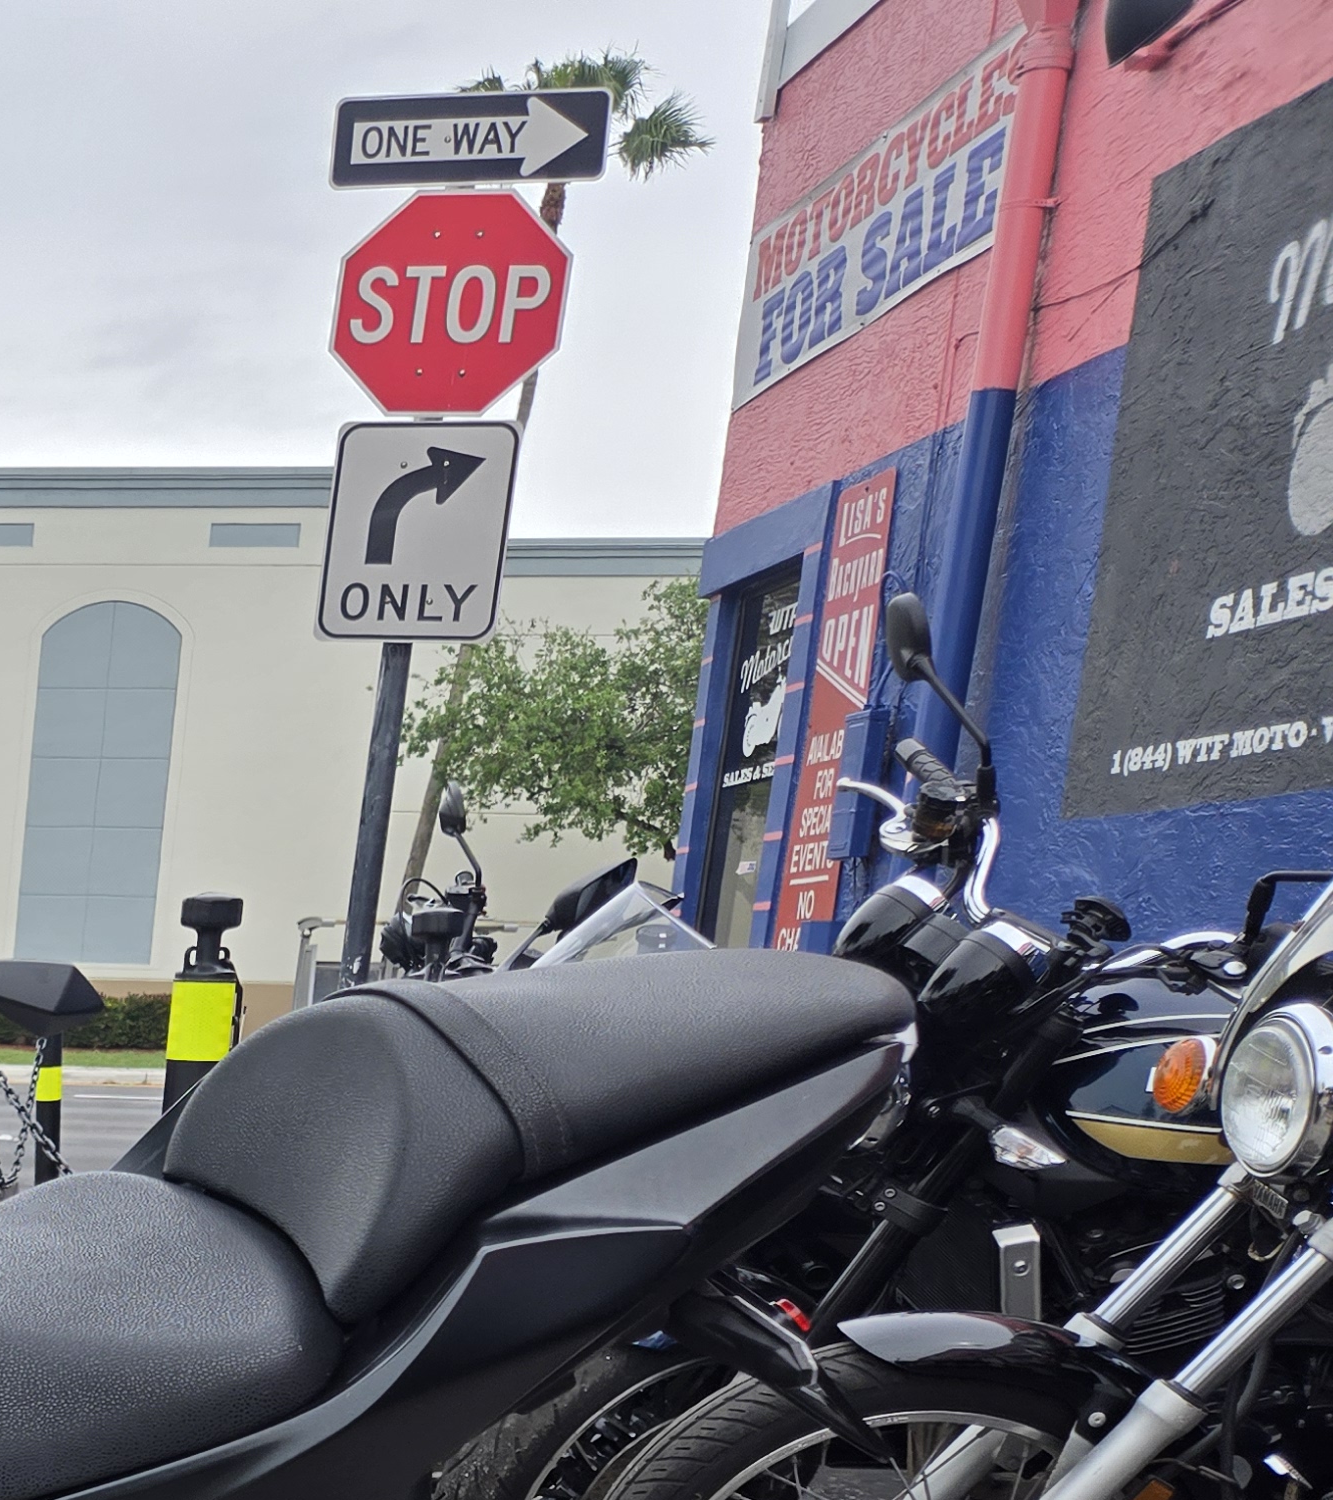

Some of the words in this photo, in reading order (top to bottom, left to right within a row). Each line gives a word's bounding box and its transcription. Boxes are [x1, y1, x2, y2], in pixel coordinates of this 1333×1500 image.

[361, 124, 432, 159] ONE
[452, 120, 528, 155] WAY
[753, 245, 847, 386] FOR
[855, 125, 1008, 316] SALE
[349, 264, 551, 344] STOP
[838, 487, 887, 548] LISA'S
[340, 582, 478, 622] ONLY
[1205, 567, 1333, 639] SALES
[740, 635, 794, 694] Motorc
[822, 604, 875, 689] OPEN
[806, 729, 845, 766] AVAILAB
[1176, 733, 1230, 765] WTF
[1230, 721, 1309, 758] MOTO
[761, 761, 775, 779] SE
[813, 768, 835, 800] FOR
[799, 803, 832, 838] SPECIA
[796, 890, 815, 920] NO
